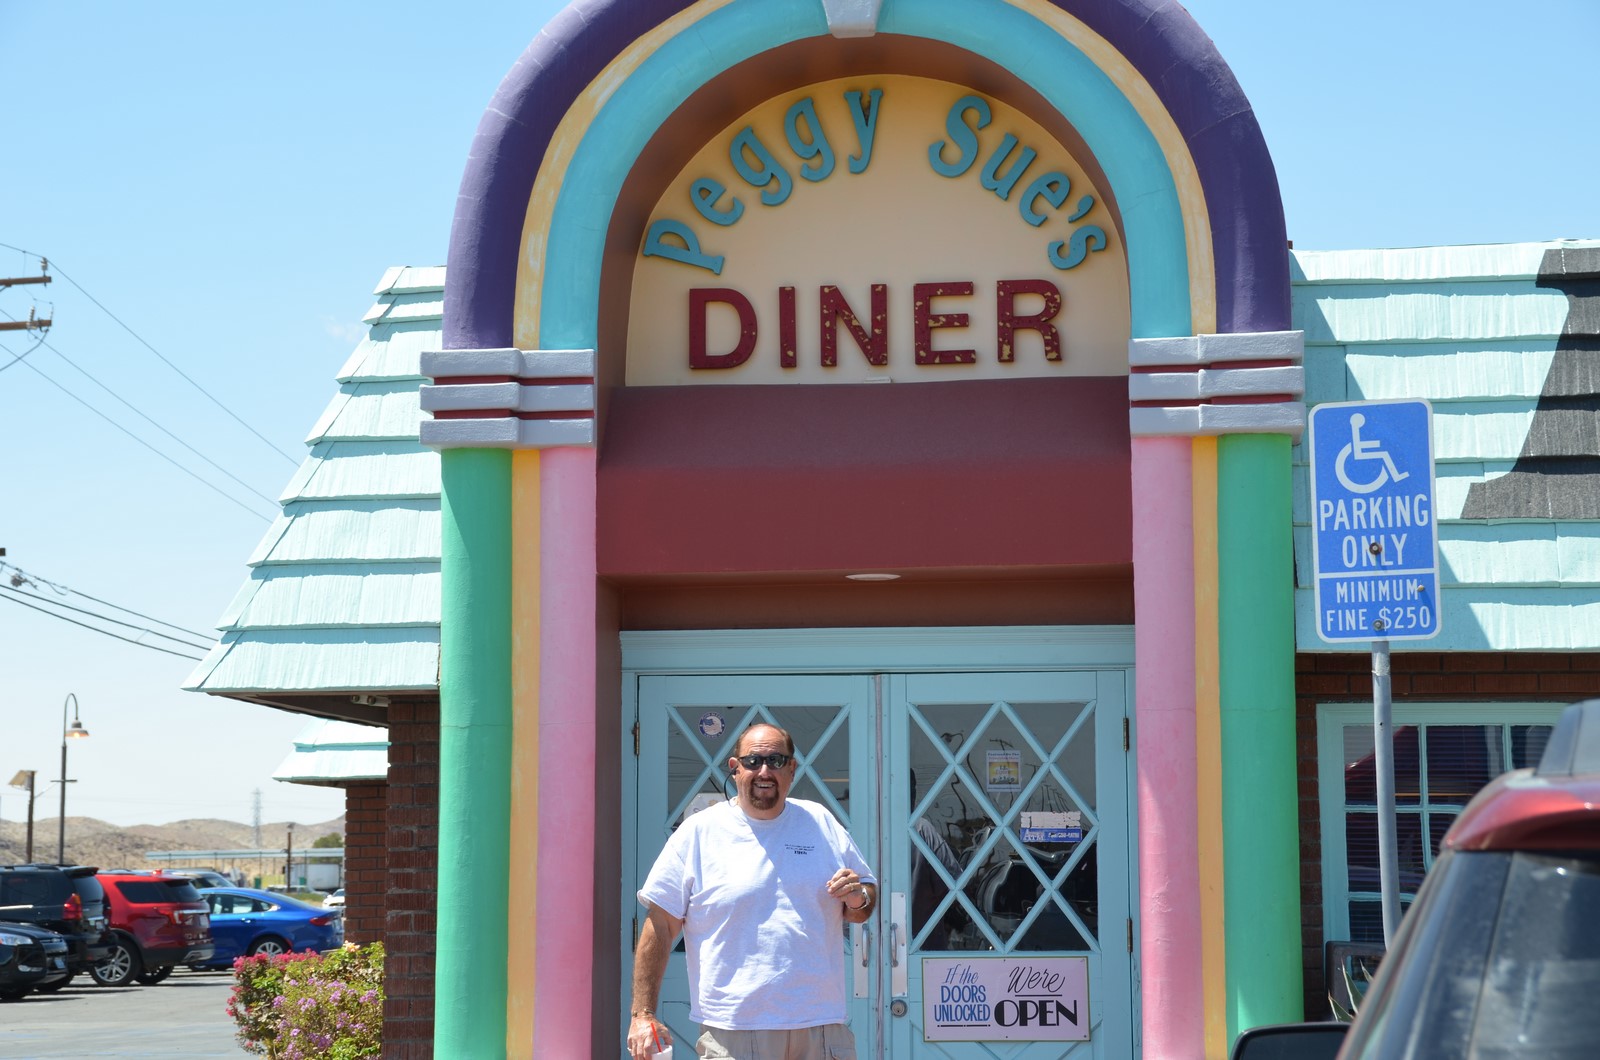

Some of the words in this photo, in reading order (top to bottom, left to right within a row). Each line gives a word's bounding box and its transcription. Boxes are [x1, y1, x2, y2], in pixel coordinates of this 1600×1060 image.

[643, 88, 883, 275] Peggy
[928, 95, 1107, 270] Sue's
[688, 278, 1063, 370] DINER
[1320, 494, 1429, 531] PARKING
[1342, 533, 1408, 568] ONLY
[1336, 578, 1419, 603] MINIMUM
[1326, 608, 1368, 631] FINE
[1379, 606, 1431, 631] $250
[942, 963, 961, 984] If
[959, 965, 979, 985] the
[940, 985, 987, 1004] DOORS
[934, 1004, 991, 1022] UNLOCKED
[994, 1000, 1078, 1027] OPEN
